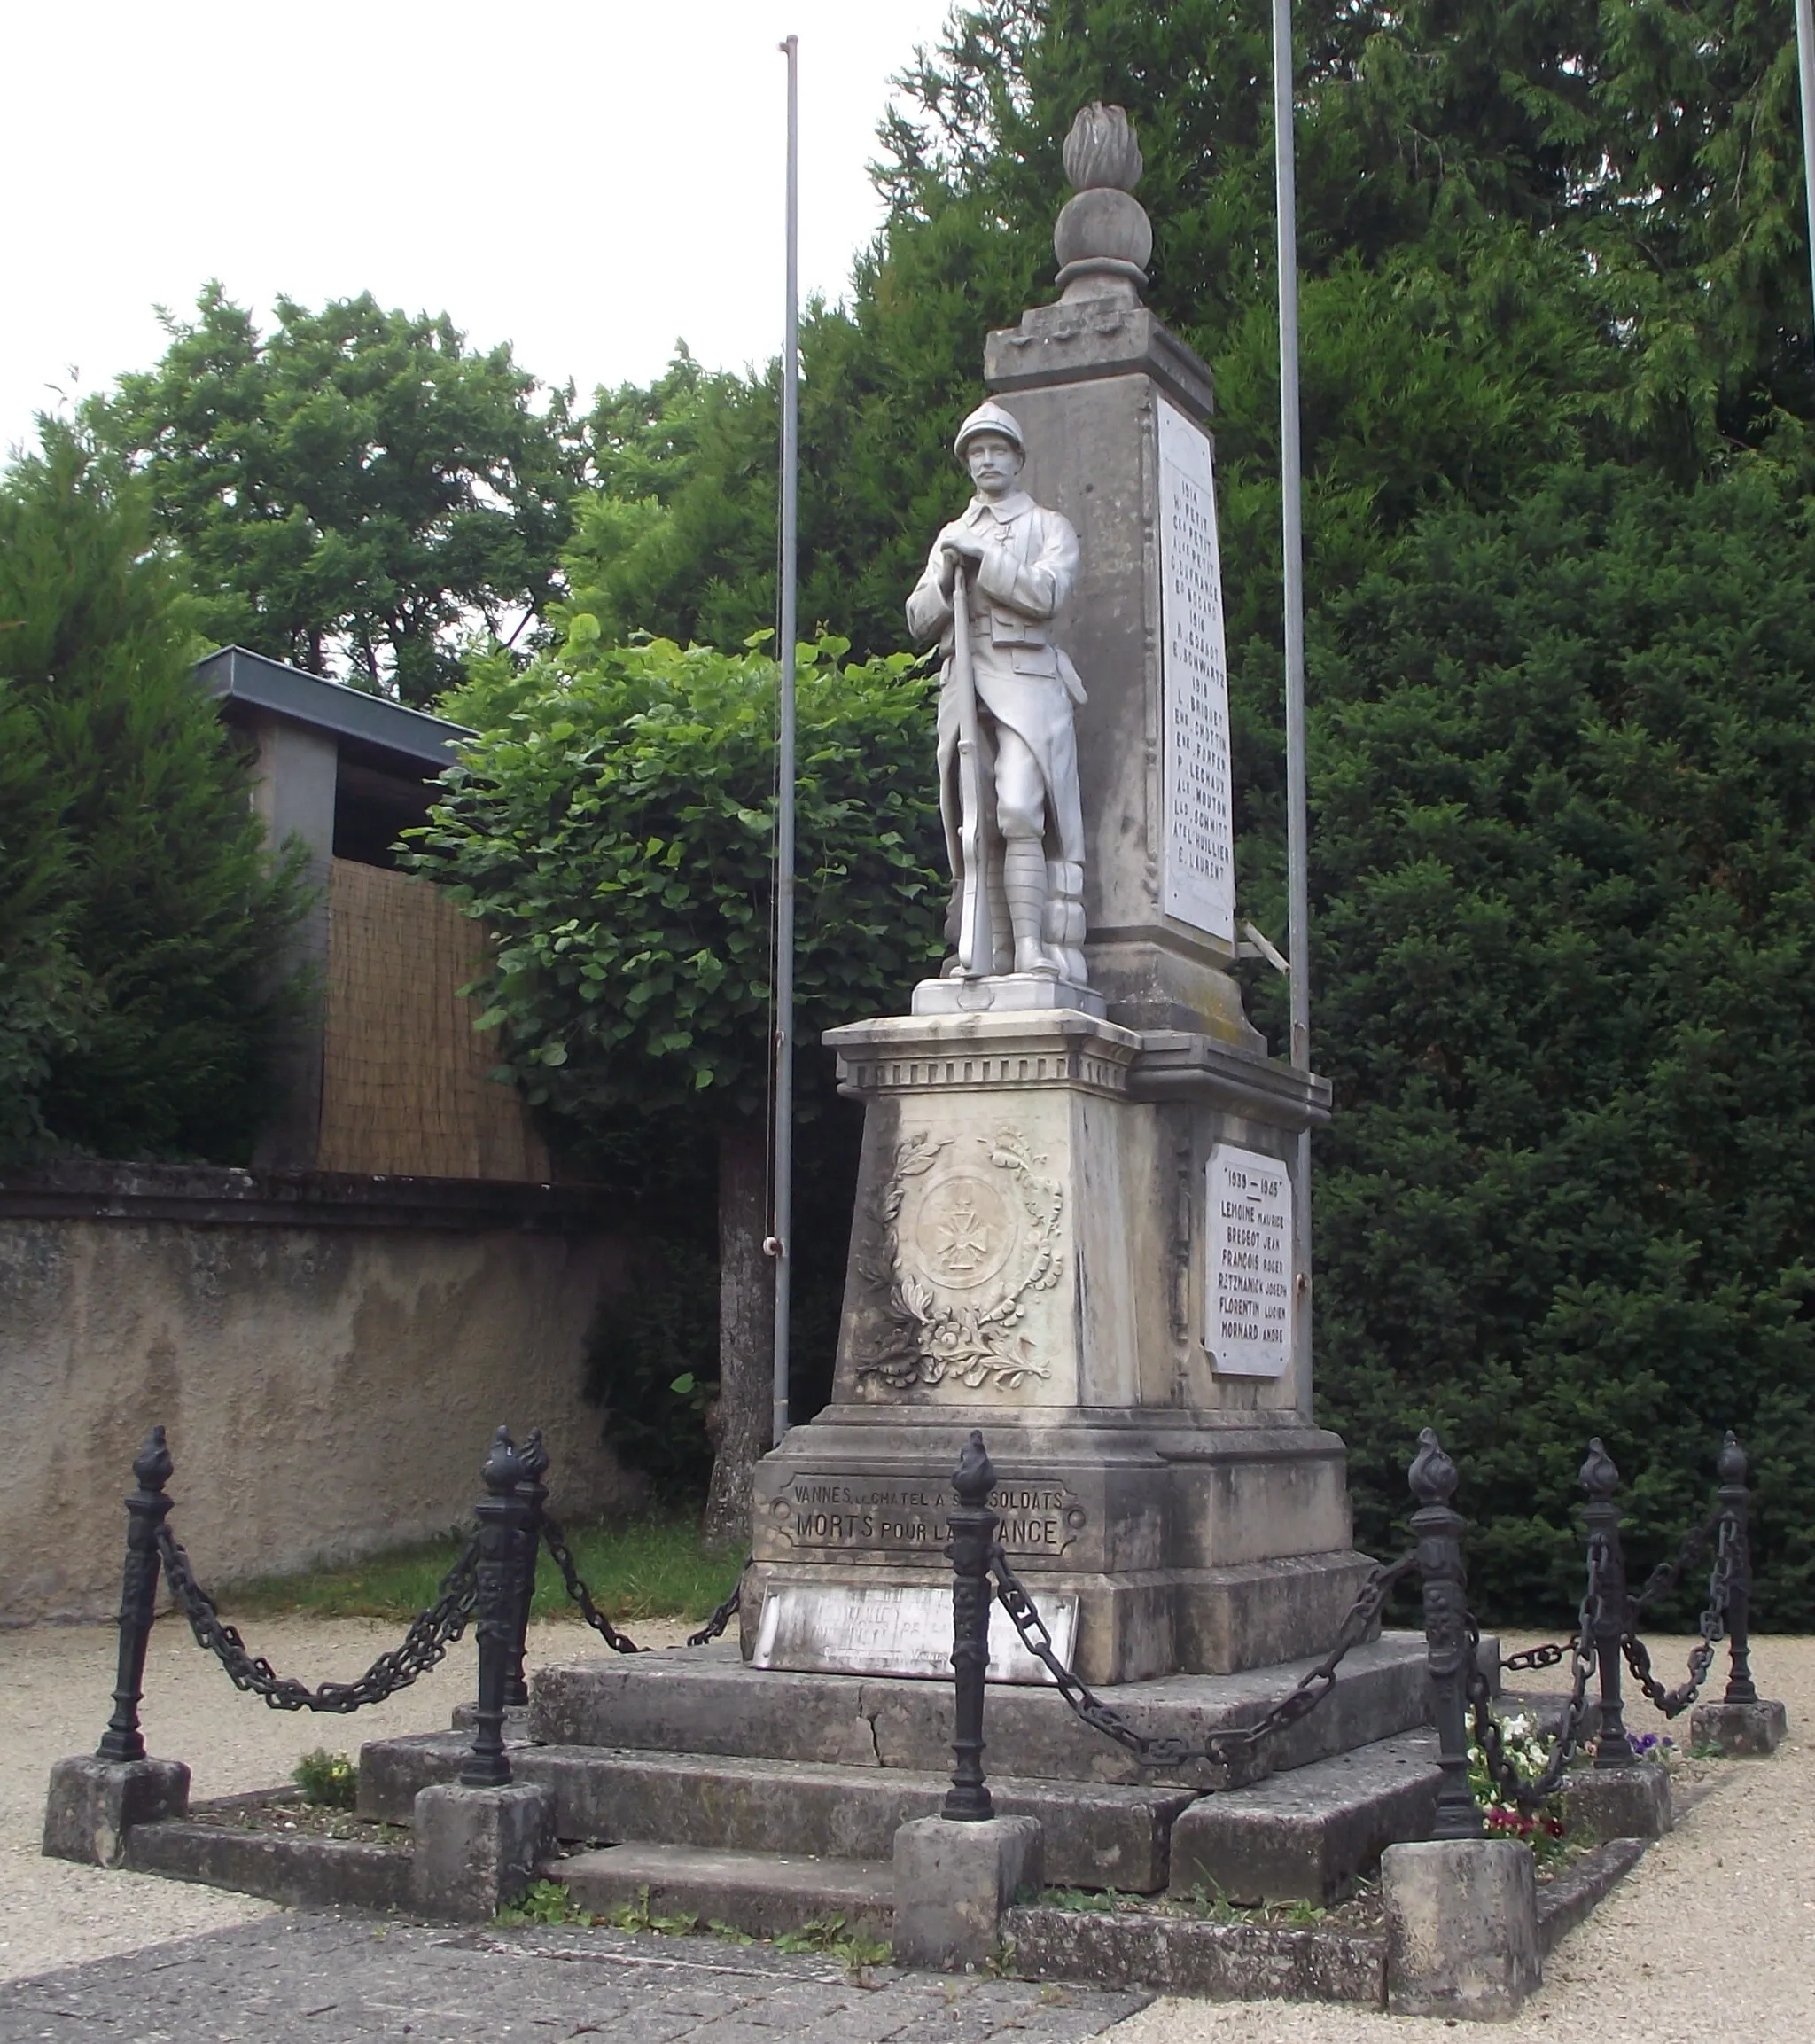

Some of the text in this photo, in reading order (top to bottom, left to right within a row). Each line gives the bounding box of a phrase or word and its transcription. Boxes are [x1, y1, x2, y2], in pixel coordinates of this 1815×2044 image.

[1181, 479, 1198, 506] 1914
[1185, 503, 1208, 533] PETIT
[1188, 526, 1211, 556] PETIT
[1191, 549, 1214, 579] PETIT
[1192, 675, 1208, 699] 1918
[1196, 786, 1227, 818] MOUTON
[1188, 851, 1225, 881] LAURENT
[1221, 1199, 1256, 1223] LEMOINE
[1263, 1237, 1281, 1251] JEAN
[1222, 1248, 1283, 1274] FRANÇOIS ROGER
[1219, 1295, 1260, 1318] FLORENTIN
[989, 1491, 1063, 1510] SOLDATS
[797, 1514, 873, 1538] MORTS
[881, 1522, 926, 1541] POUR
[998, 1519, 1057, 1545] ANCE
